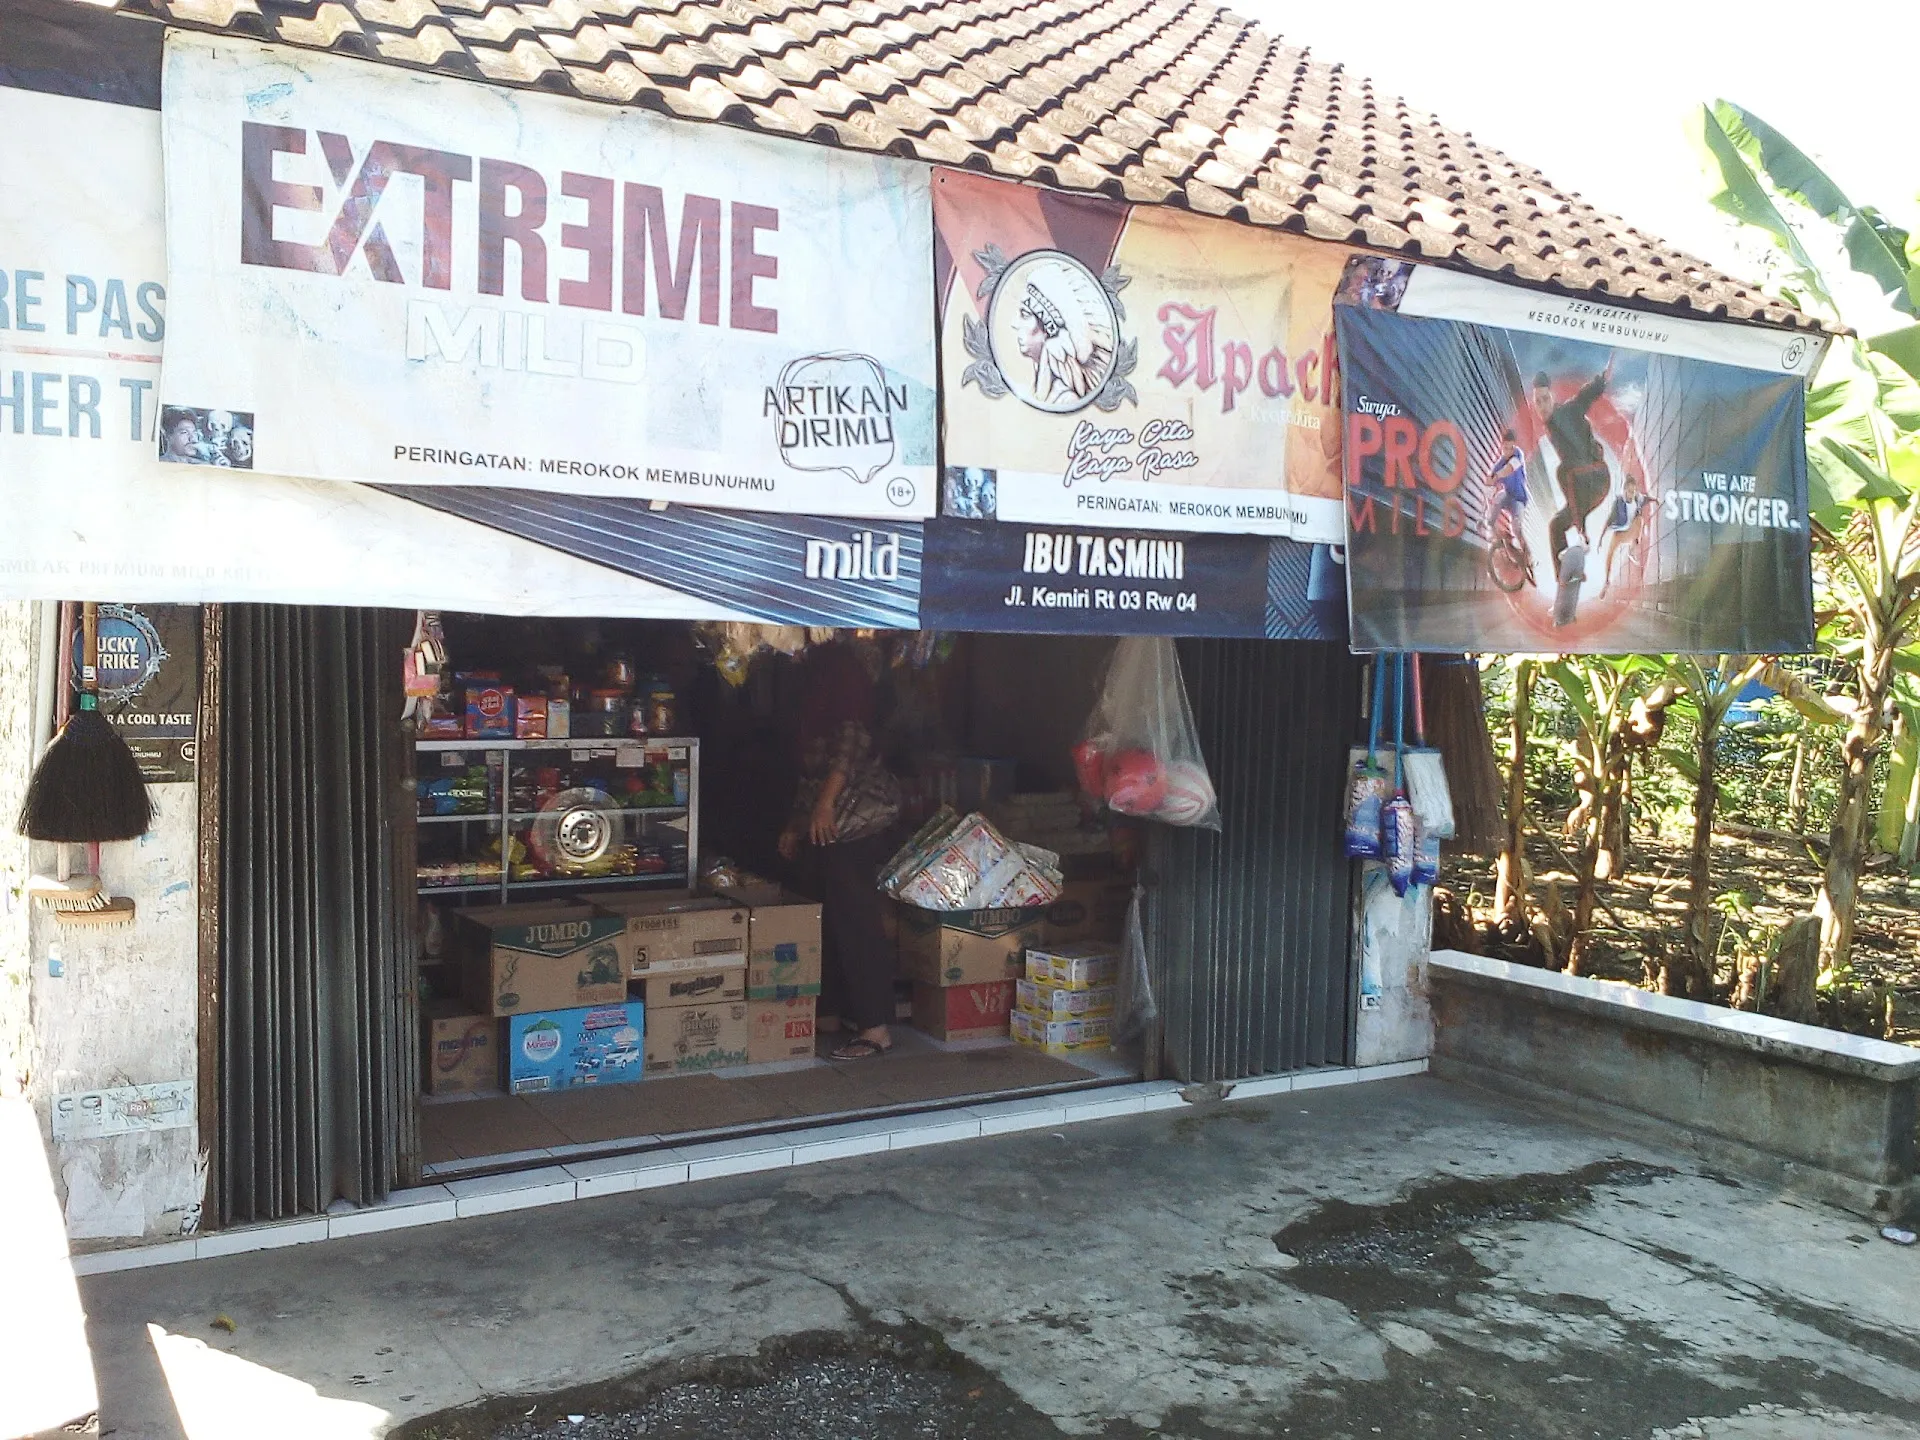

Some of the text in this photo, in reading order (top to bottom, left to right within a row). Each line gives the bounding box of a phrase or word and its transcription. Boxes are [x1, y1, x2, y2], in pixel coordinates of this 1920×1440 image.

[241, 121, 779, 333] EXTREME
[405, 299, 648, 386] MILD
[1528, 310, 1670, 344] MEROKOK MEMBUNUHMU
[120, 377, 157, 442] T
[763, 384, 908, 417] ARTIKAN
[1356, 395, 1401, 422] Surya
[780, 417, 894, 449] DIRIMU
[1067, 418, 1195, 458] Kaya Cita
[393, 445, 776, 492] PERINGATAN: MEROKOK MEMBUNUHMU
[1063, 447, 1199, 488] Kaya Rasa
[1348, 412, 1468, 494] PRO
[890, 486, 912, 497] 18+
[1702, 471, 1757, 494] WE ARE
[1076, 494, 1162, 514] PERINGATAN:
[1169, 501, 1233, 518] MEROKOK
[1347, 494, 1467, 538] MILD
[1664, 488, 1802, 529] STRONGER.
[804, 530, 901, 582] mild
[1023, 532, 1184, 580] IBU TASMINI
[1032, 586, 1090, 609] Kemiri
[1094, 589, 1115, 609] Rt
[1119, 590, 1141, 610] 03
[1146, 591, 1173, 612] Rw
[1177, 592, 1197, 612] 04
[97, 636, 139, 652] UCKY
[97, 653, 140, 670] TRIKE
[117, 714, 125, 725] A
[127, 713, 157, 725] COOL
[159, 713, 192, 726] TASTE
[525, 919, 592, 944] JUMBO
[636, 947, 647, 963] 5
